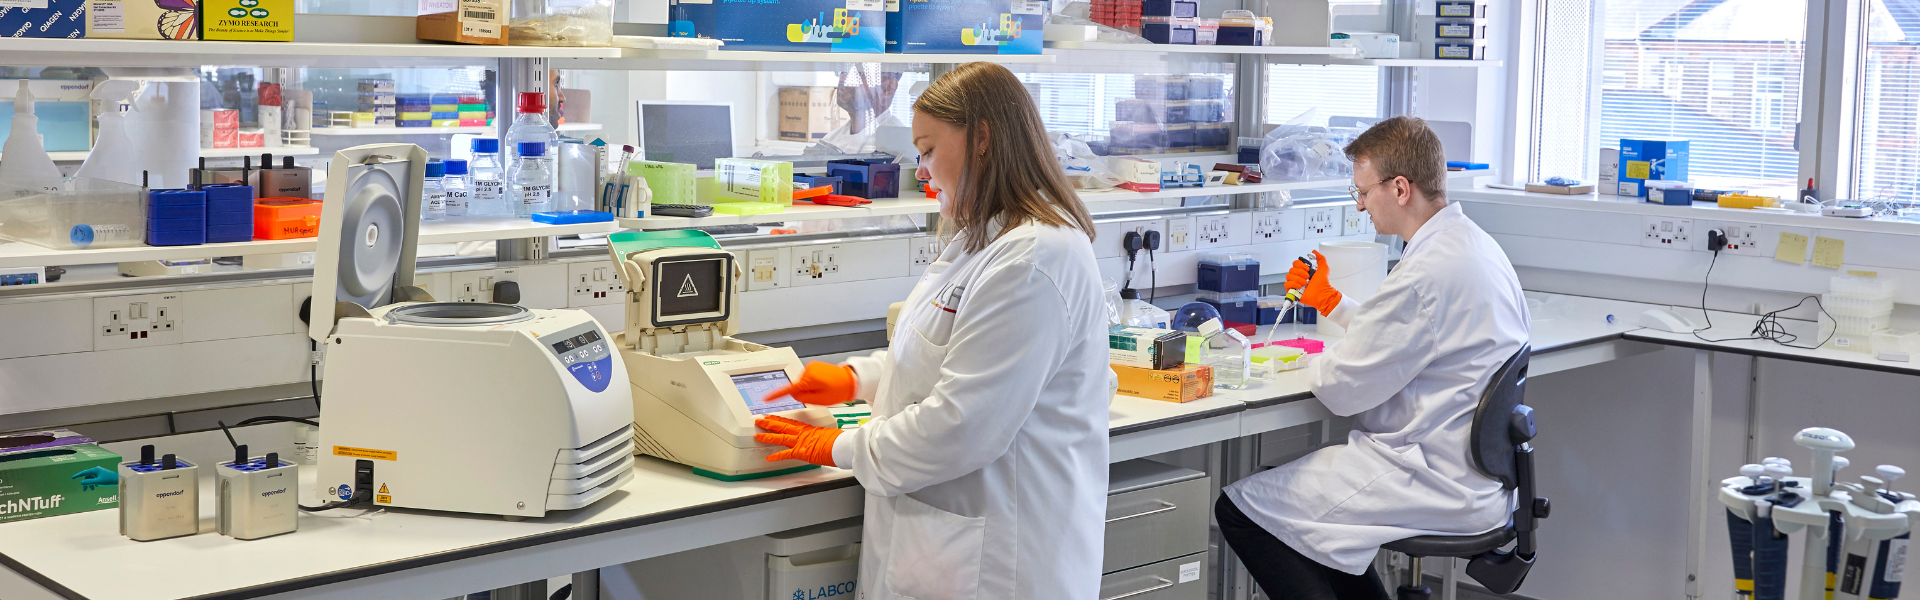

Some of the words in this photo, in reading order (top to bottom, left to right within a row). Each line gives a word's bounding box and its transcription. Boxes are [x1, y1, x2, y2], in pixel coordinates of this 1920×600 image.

[40, 10, 63, 32] QIAGEN
[241, 20, 279, 28] RESEARCH
[12, 21, 32, 38] QIAGE
[156, 489, 184, 498] eppendorf
[261, 487, 287, 498] eppendorf
[98, 494, 117, 504] Ansell
[808, 580, 858, 600] LABCO
